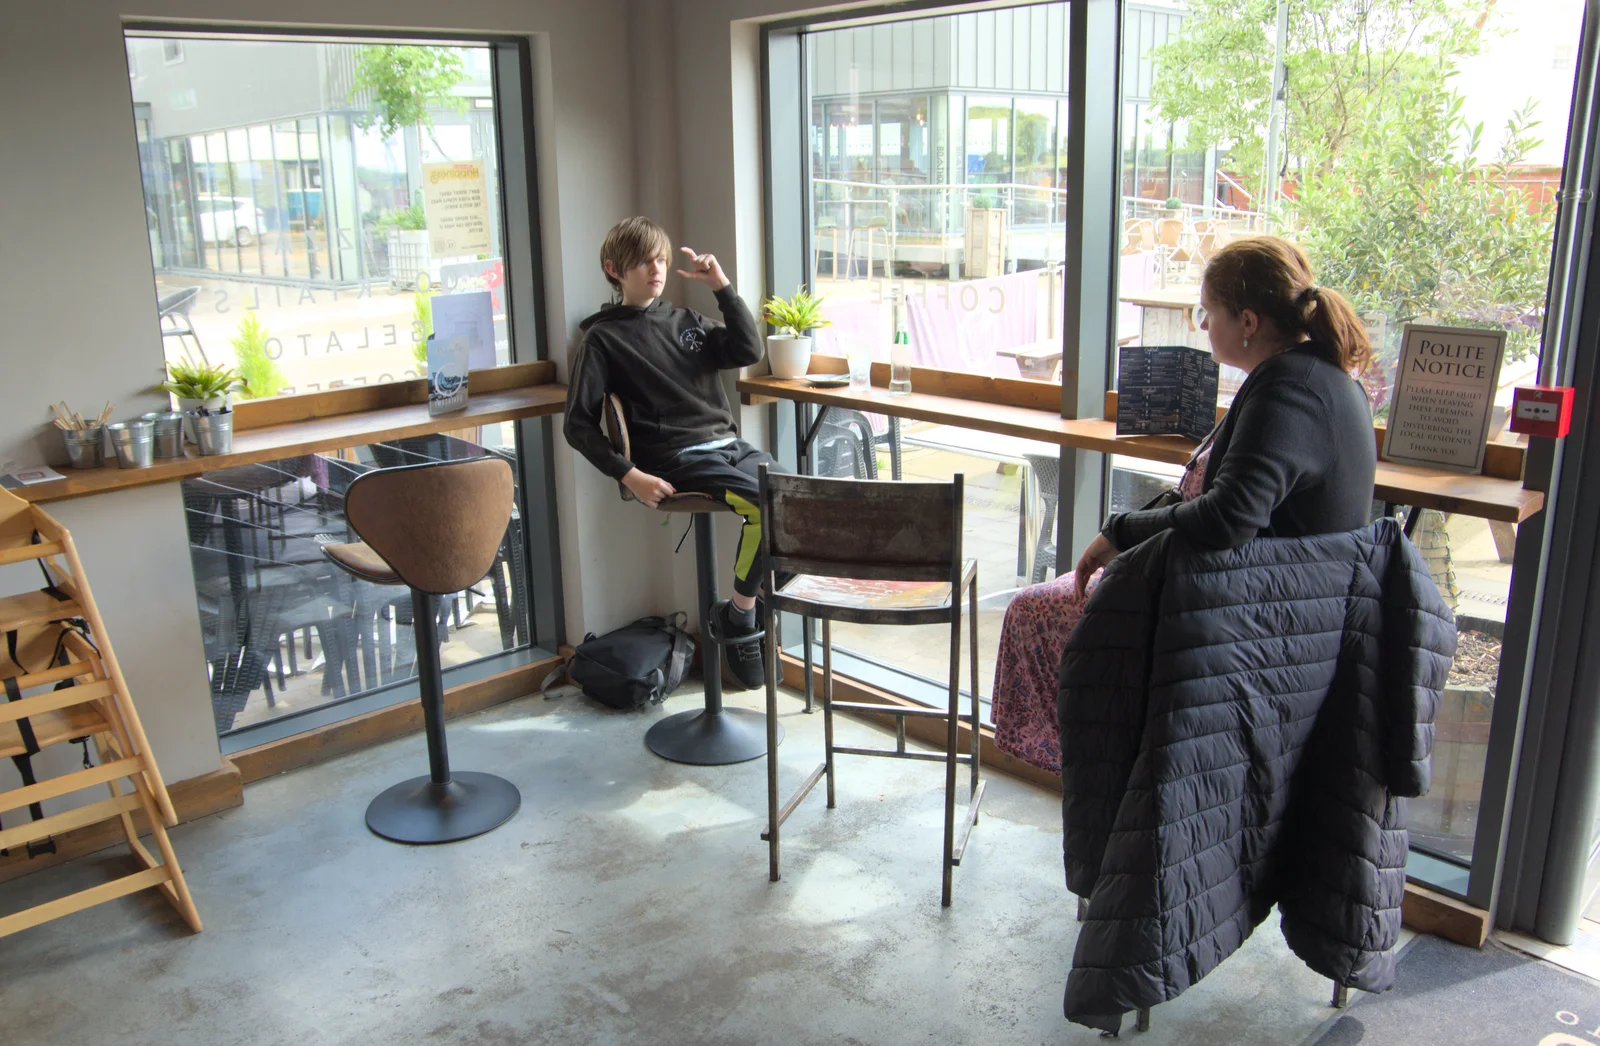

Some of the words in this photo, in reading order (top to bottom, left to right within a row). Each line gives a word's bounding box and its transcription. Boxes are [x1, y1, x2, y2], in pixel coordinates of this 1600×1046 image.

[1420, 340, 1486, 360] POLITE
[1412, 358, 1486, 379] NOTICE
[1406, 385, 1433, 395] PLEASE
[1434, 389, 1456, 397] KEEP
[1457, 391, 1483, 400] QUIET
[1411, 396, 1437, 404] WHEN
[1439, 398, 1474, 408] LEAVING
[1408, 404, 1434, 413] THESE
[1435, 407, 1474, 417] PREMISES
[1420, 414, 1430, 422] TO
[1432, 416, 1459, 425] AVOID
[1403, 422, 1453, 434] DISTURBING
[1456, 427, 1473, 436] THE
[1400, 430, 1425, 440] LOCAL
[1427, 434, 1472, 445] RESIDENTS
[1409, 442, 1438, 453] THANK
[1440, 447, 1458, 456] YOU
